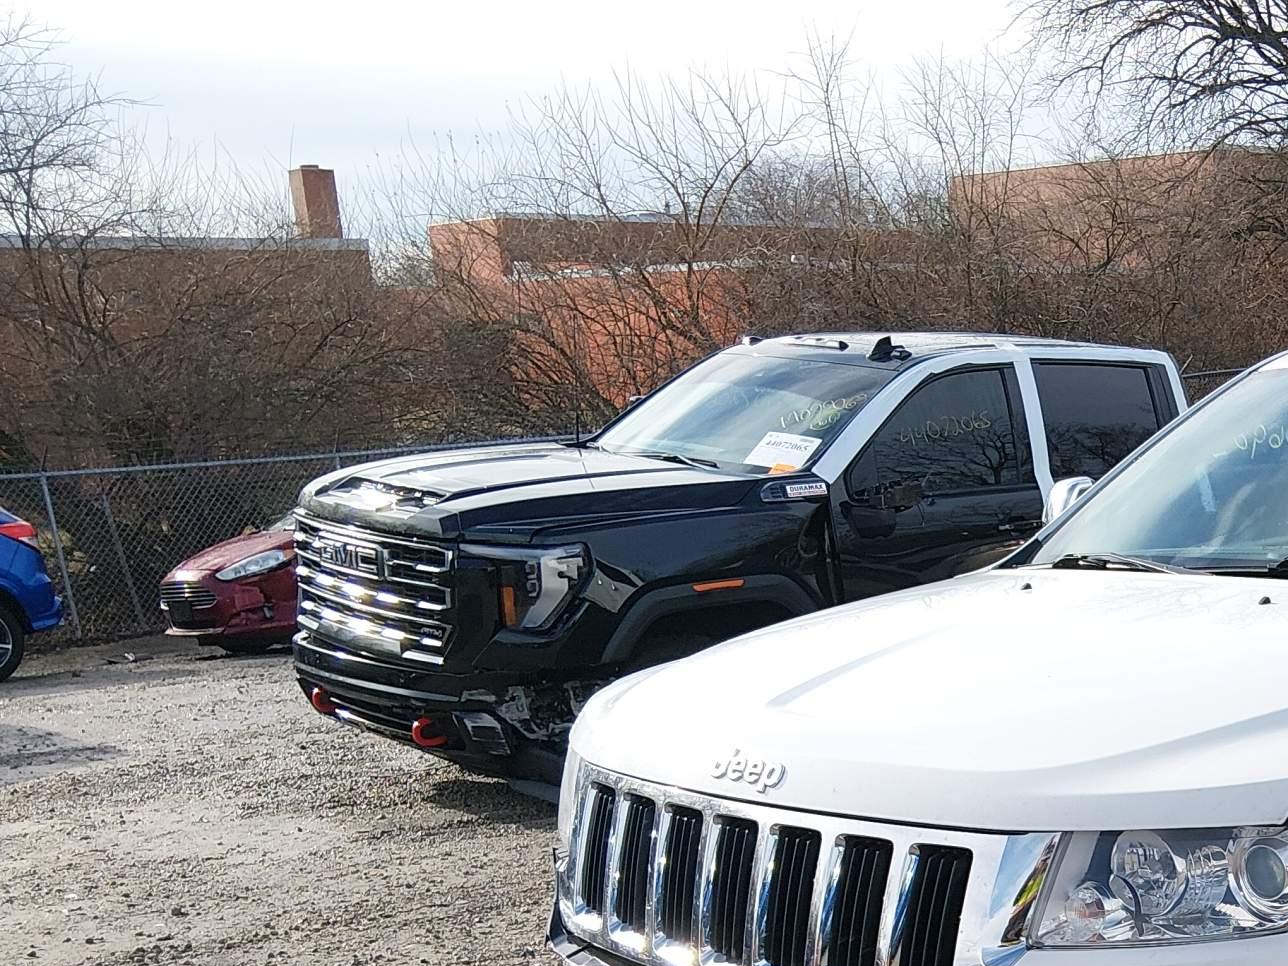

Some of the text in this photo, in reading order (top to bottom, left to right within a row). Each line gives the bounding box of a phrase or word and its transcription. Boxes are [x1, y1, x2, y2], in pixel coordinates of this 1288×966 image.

[789, 484, 823, 492] DURAMAX
[319, 539, 378, 573] GMC
[711, 746, 787, 794] Jeep
